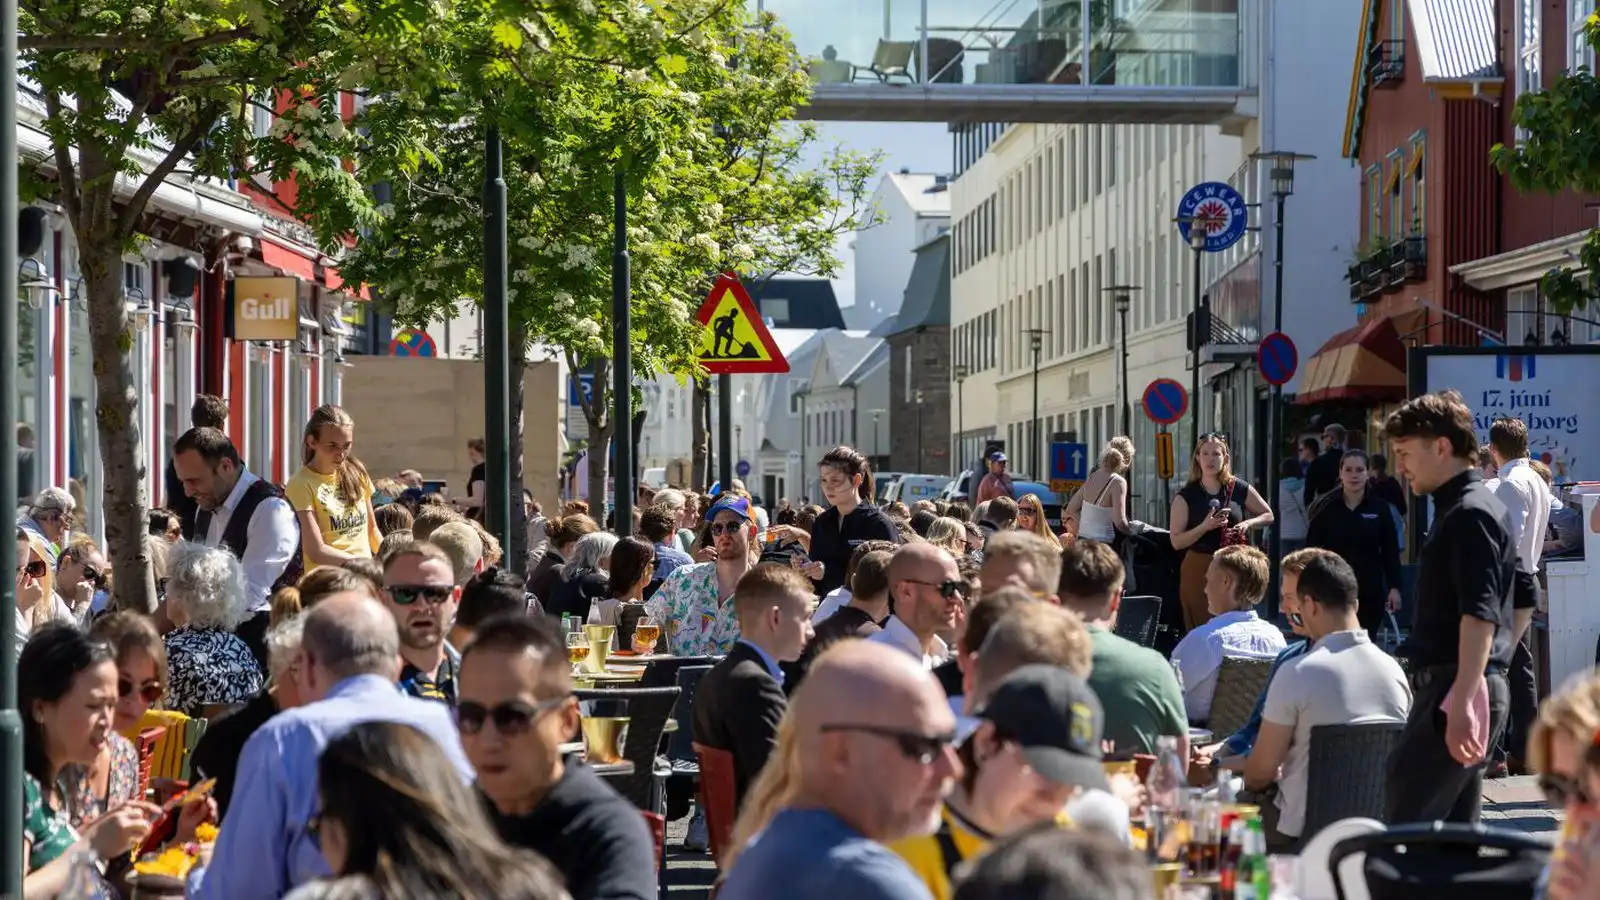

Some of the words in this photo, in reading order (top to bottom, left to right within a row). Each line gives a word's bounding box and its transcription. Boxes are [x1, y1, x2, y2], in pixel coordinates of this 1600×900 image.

[1182, 186, 1243, 216] ICEWEAR
[240, 297, 290, 320] Gull
[1482, 389, 1504, 407] 17.
[1508, 389, 1551, 410] júní
[1527, 412, 1579, 434] borg
